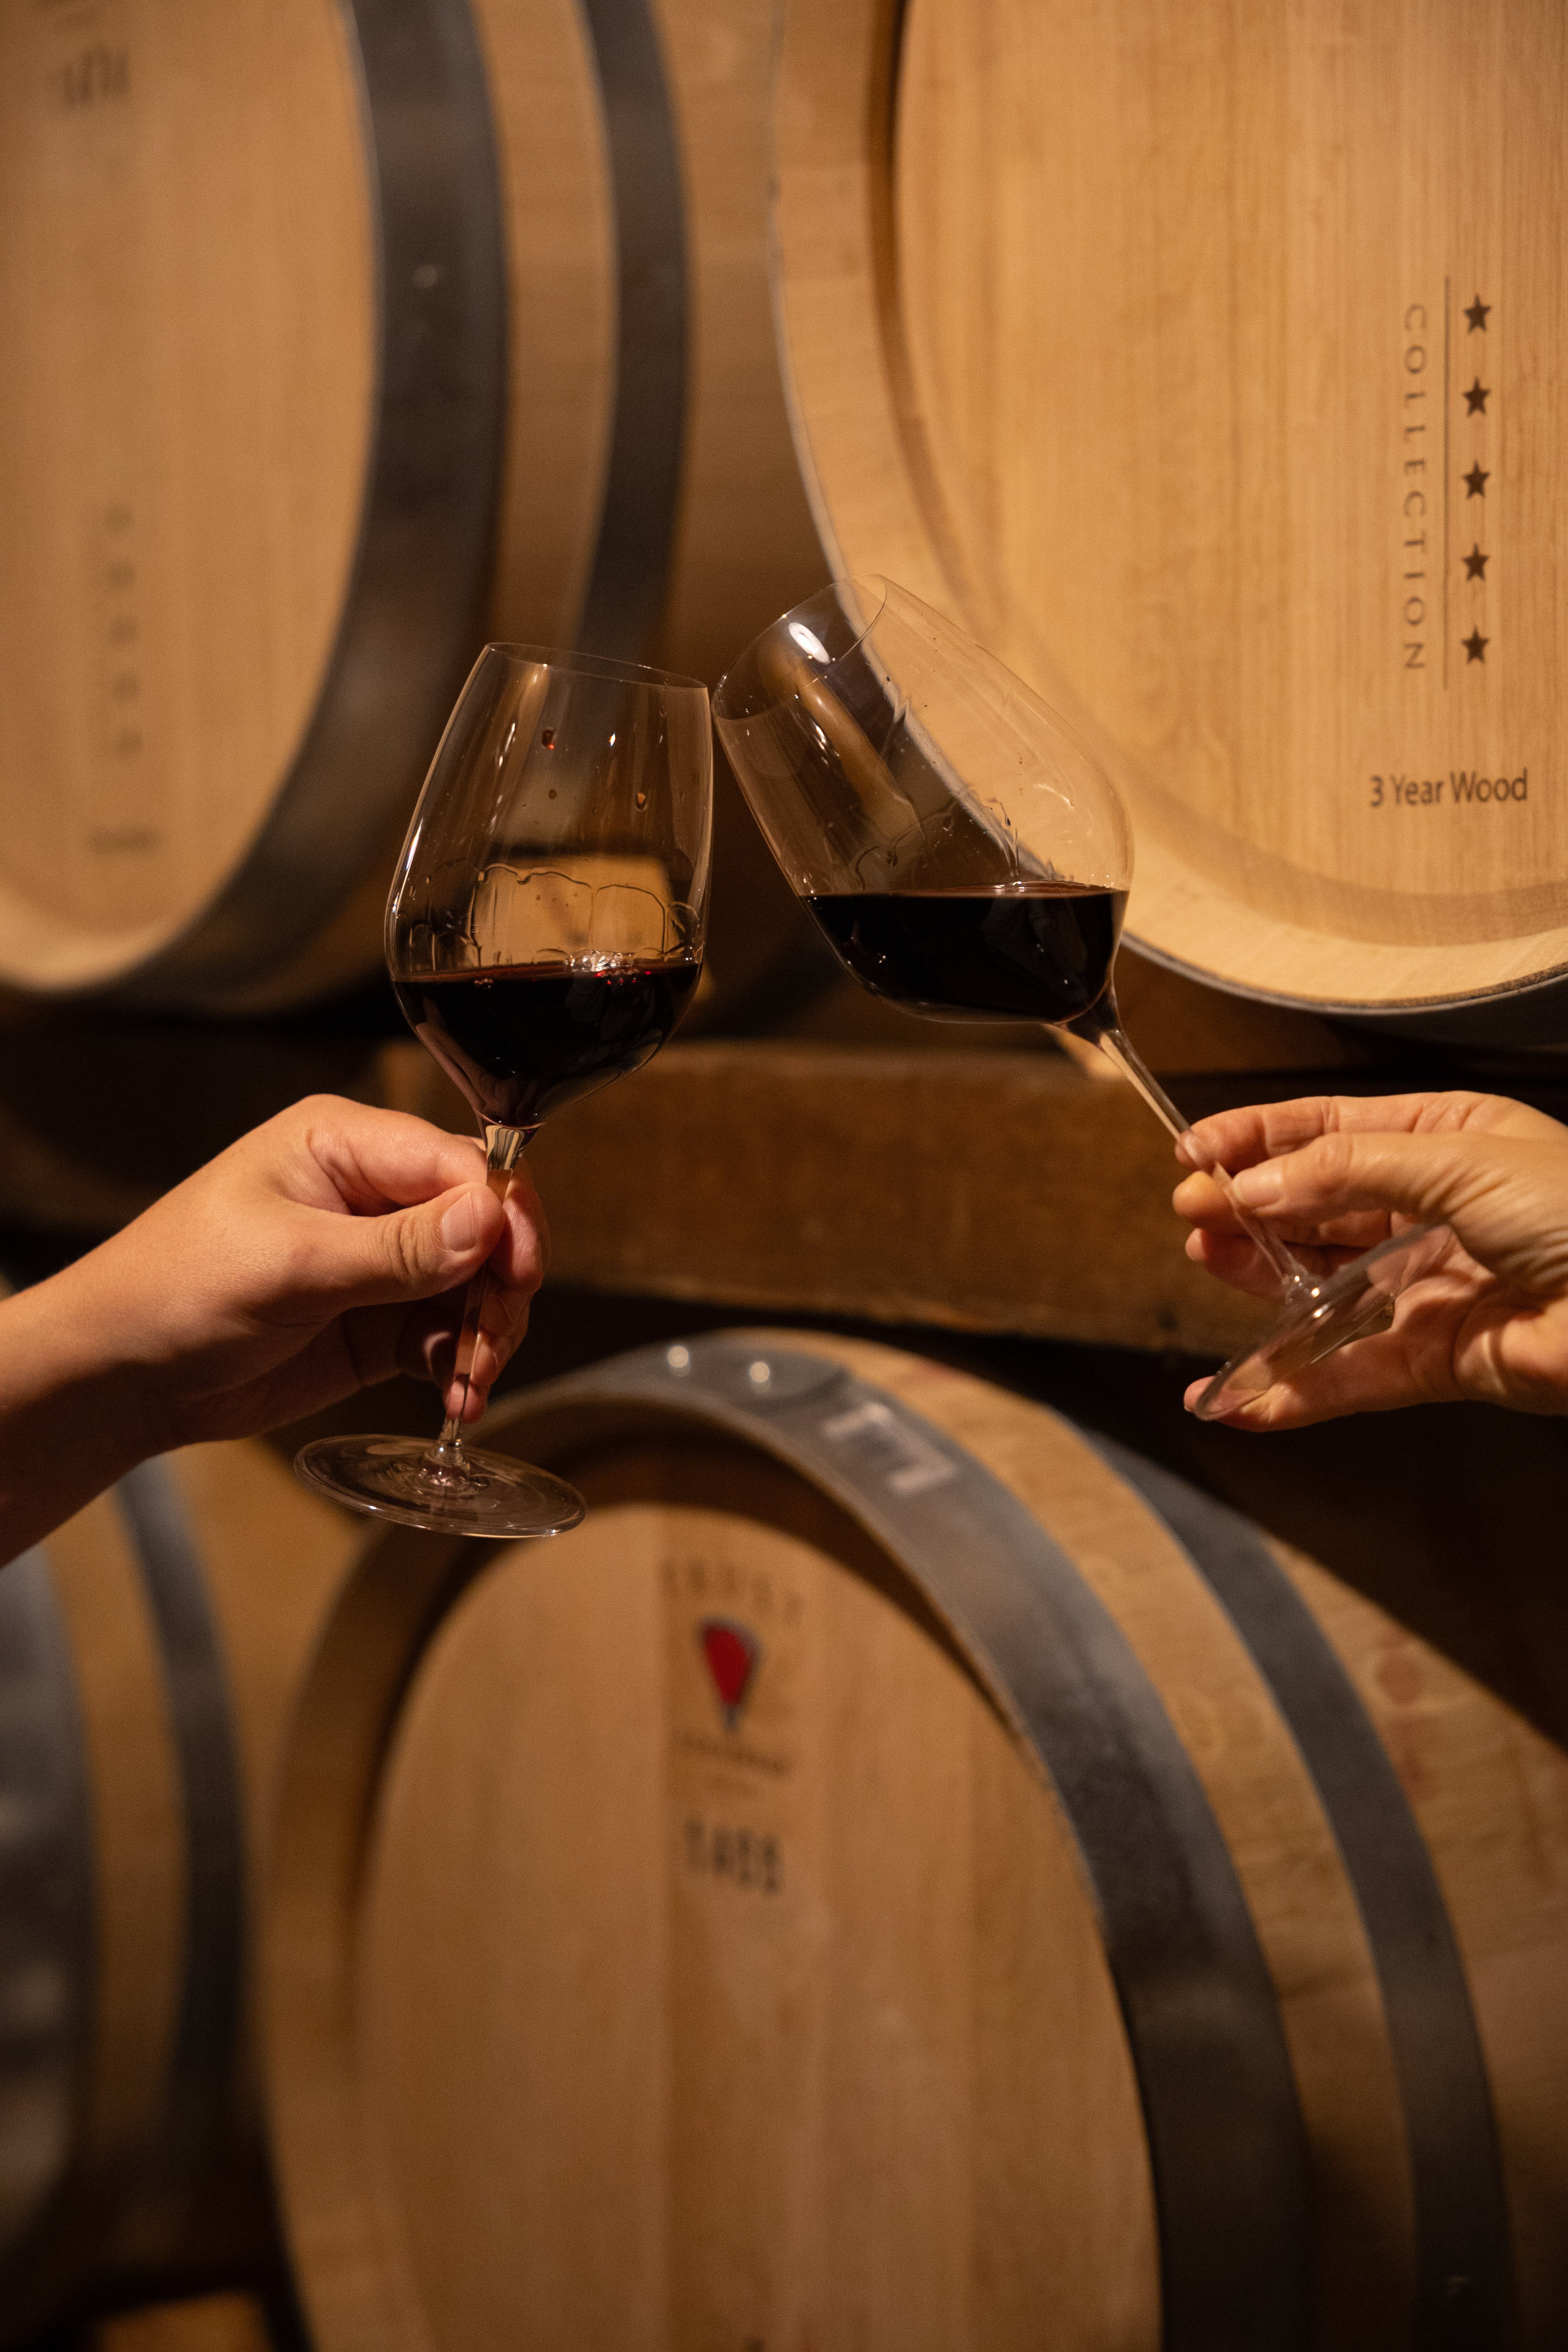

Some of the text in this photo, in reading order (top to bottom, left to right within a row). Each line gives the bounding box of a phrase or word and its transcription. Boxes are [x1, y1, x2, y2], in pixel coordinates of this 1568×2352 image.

[1403, 303, 1426, 669] COLLECTION
[1370, 767, 1527, 808] 3 Year Wood
